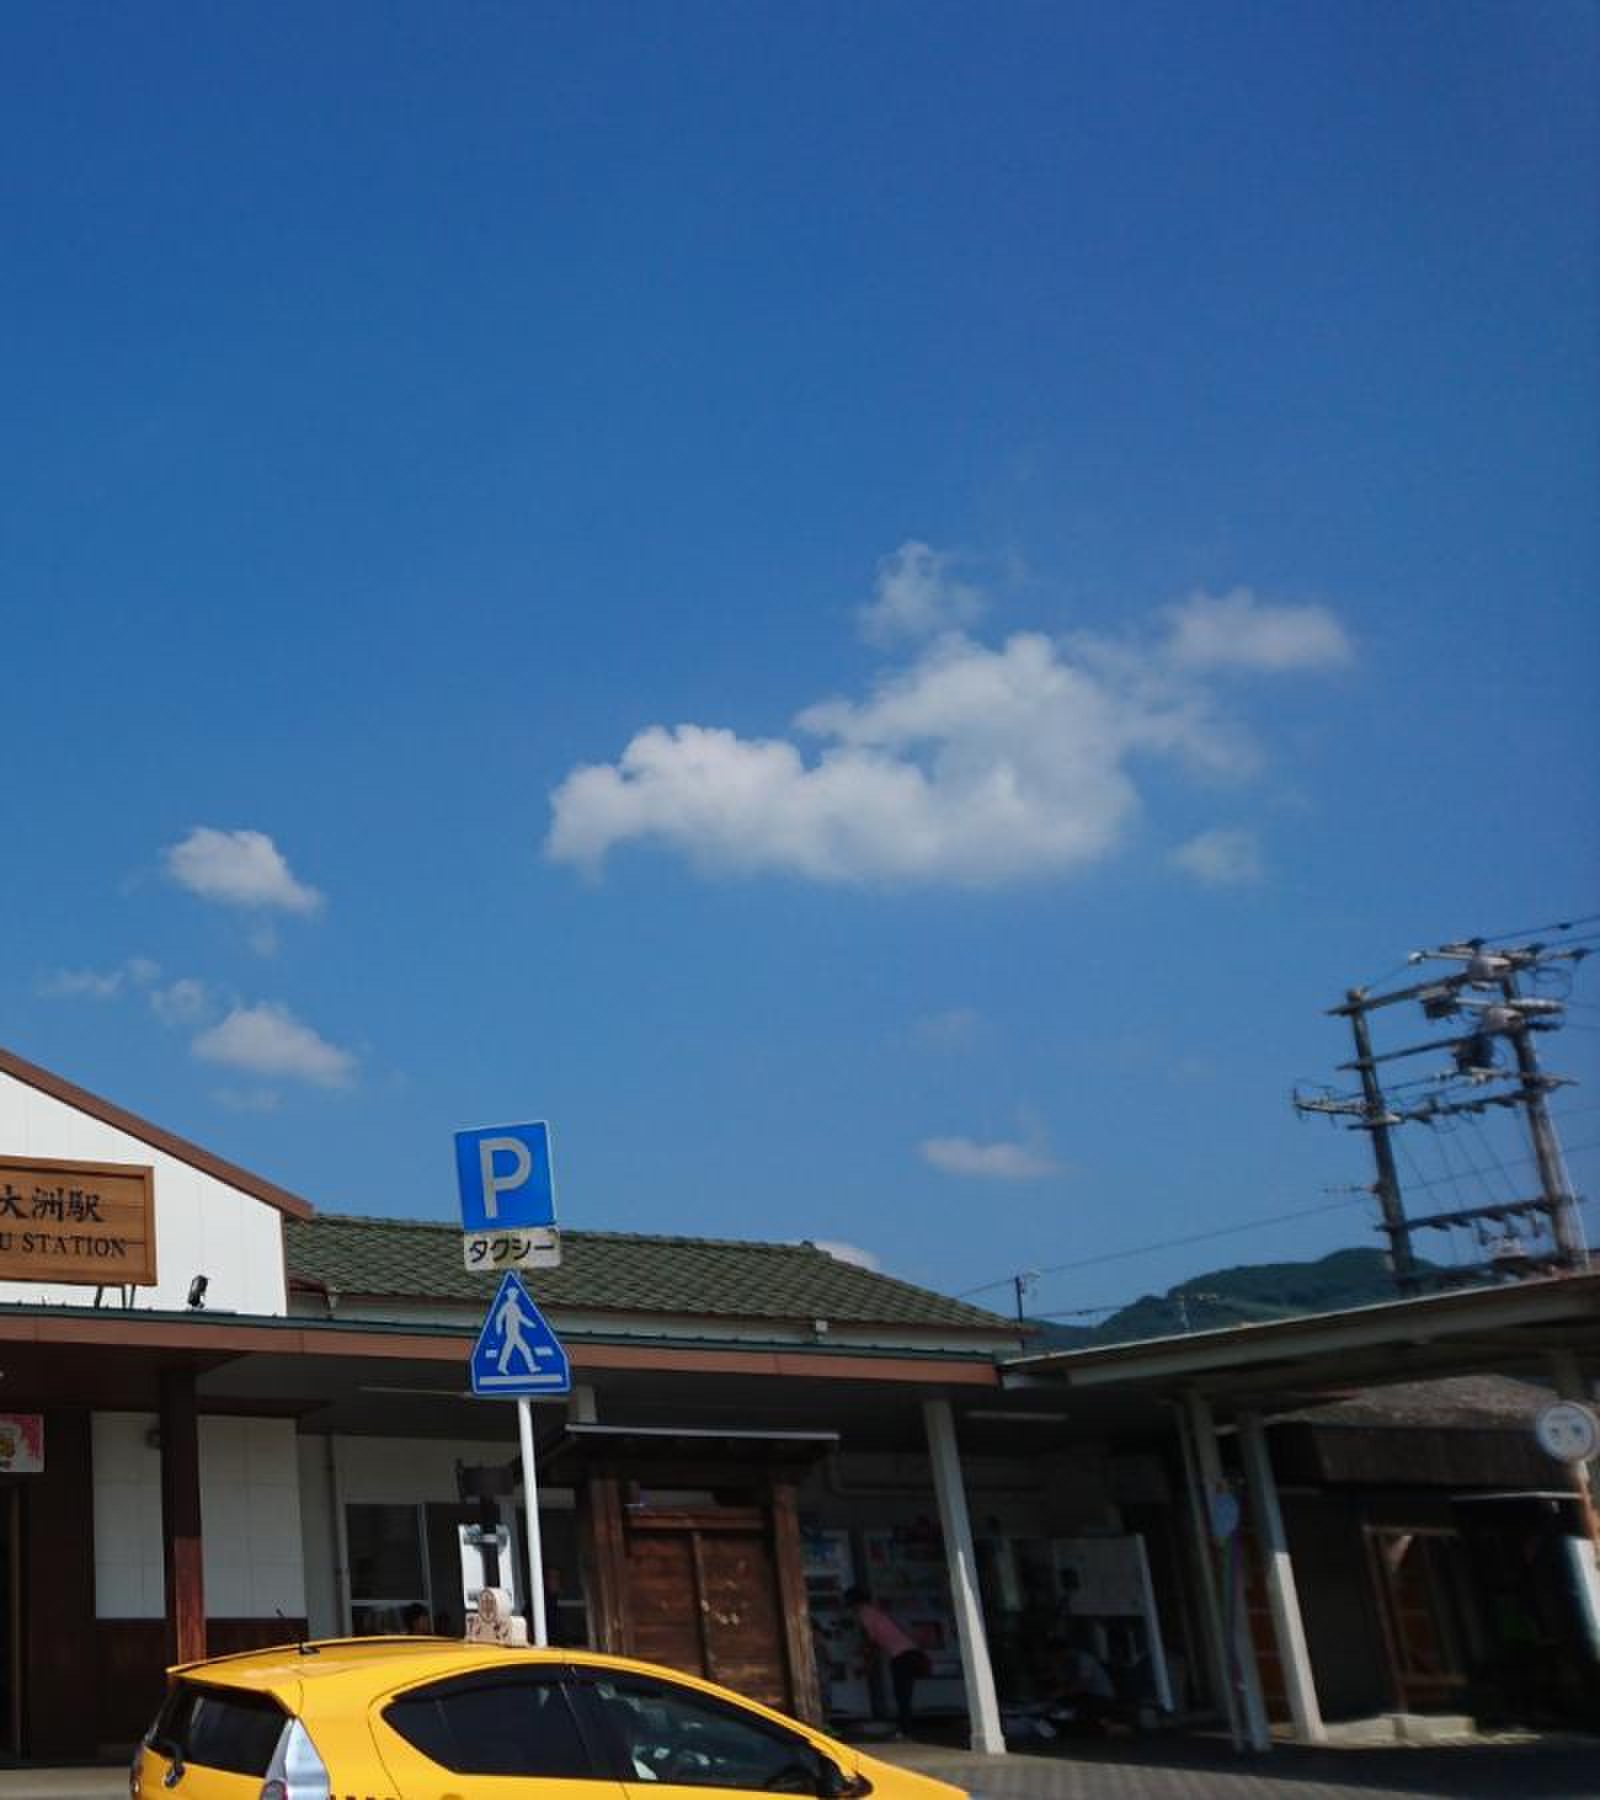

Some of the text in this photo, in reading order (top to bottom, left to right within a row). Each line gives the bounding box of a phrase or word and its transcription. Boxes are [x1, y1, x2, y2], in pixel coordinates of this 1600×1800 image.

[480, 1137, 531, 1219] P
[20, 1231, 128, 1258] STATION
[469, 1238, 555, 1264] タクシー
